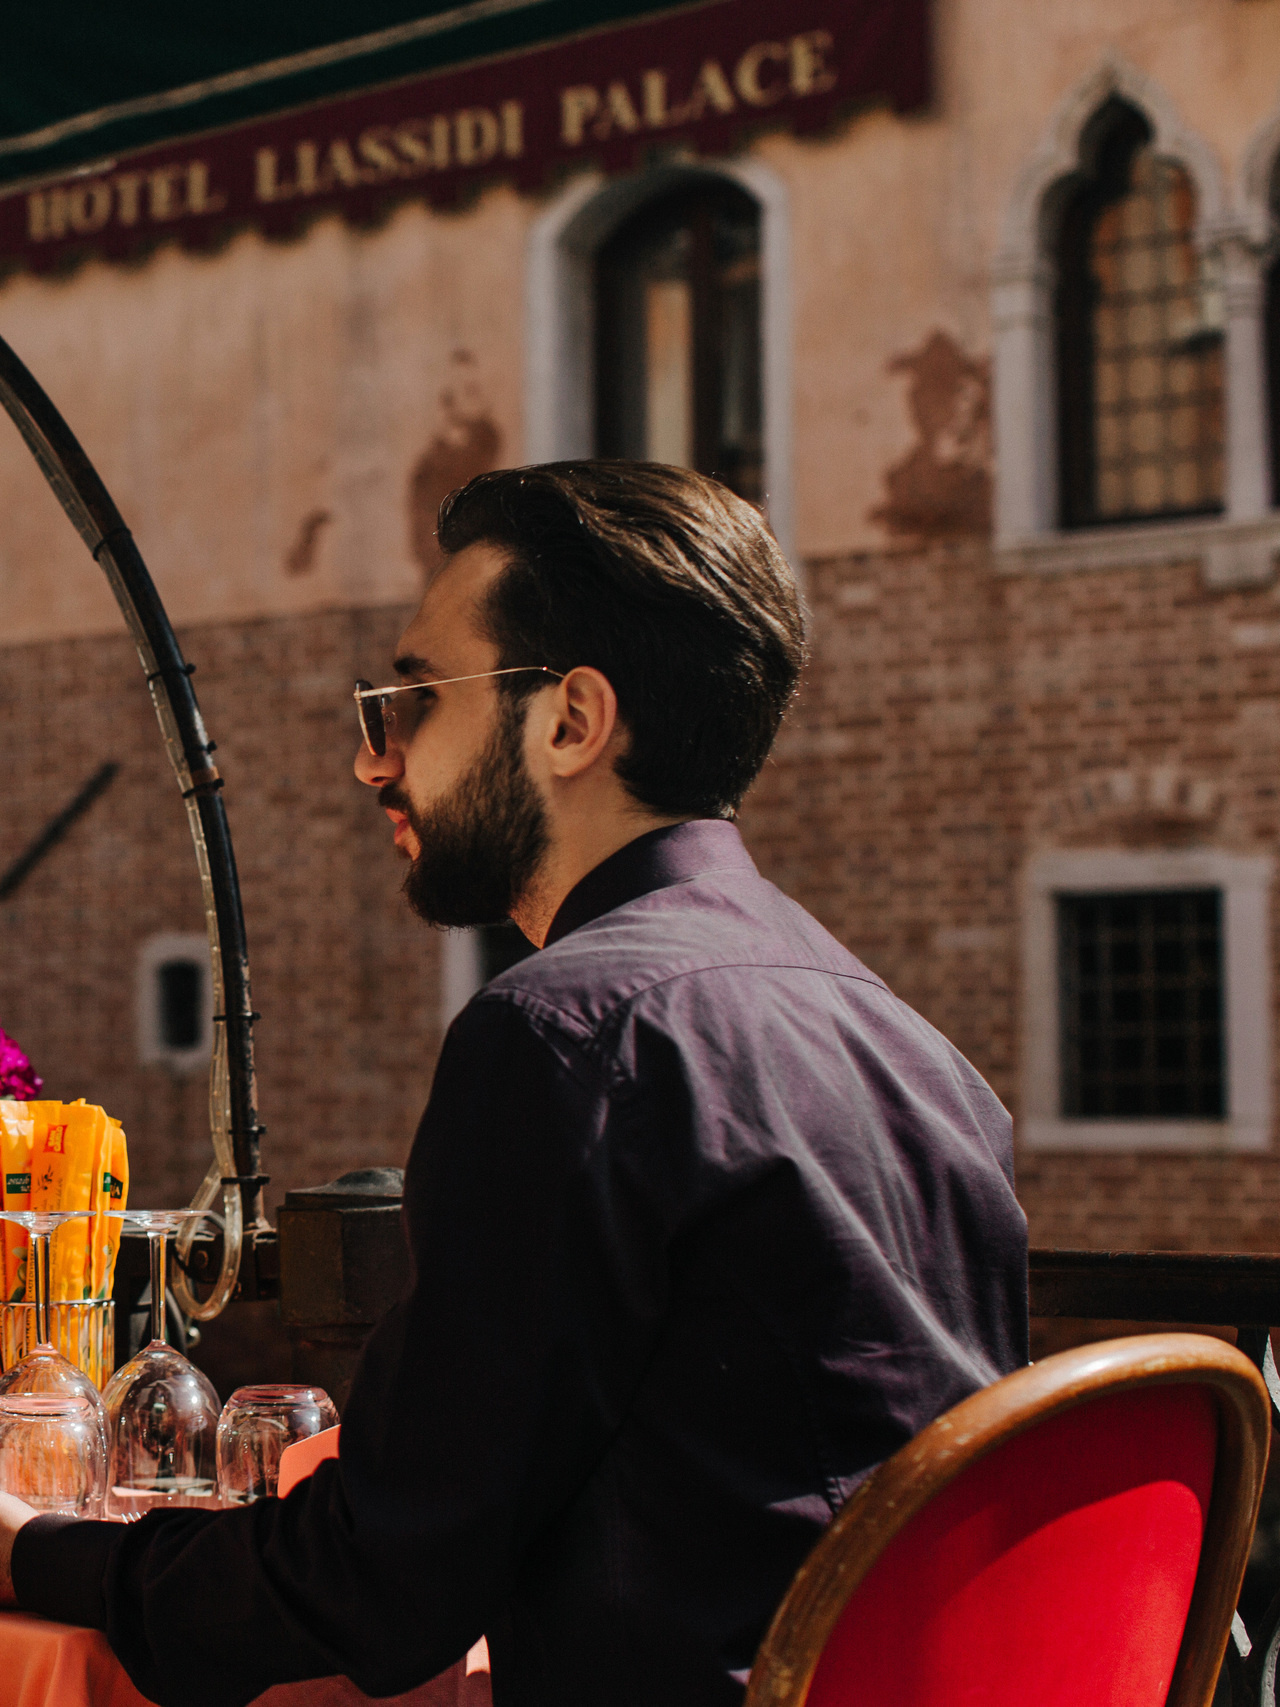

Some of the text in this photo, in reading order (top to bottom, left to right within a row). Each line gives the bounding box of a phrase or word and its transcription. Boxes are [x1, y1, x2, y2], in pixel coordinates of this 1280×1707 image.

[28, 29, 838, 242] HOTEL LIASSIDI PALACE
